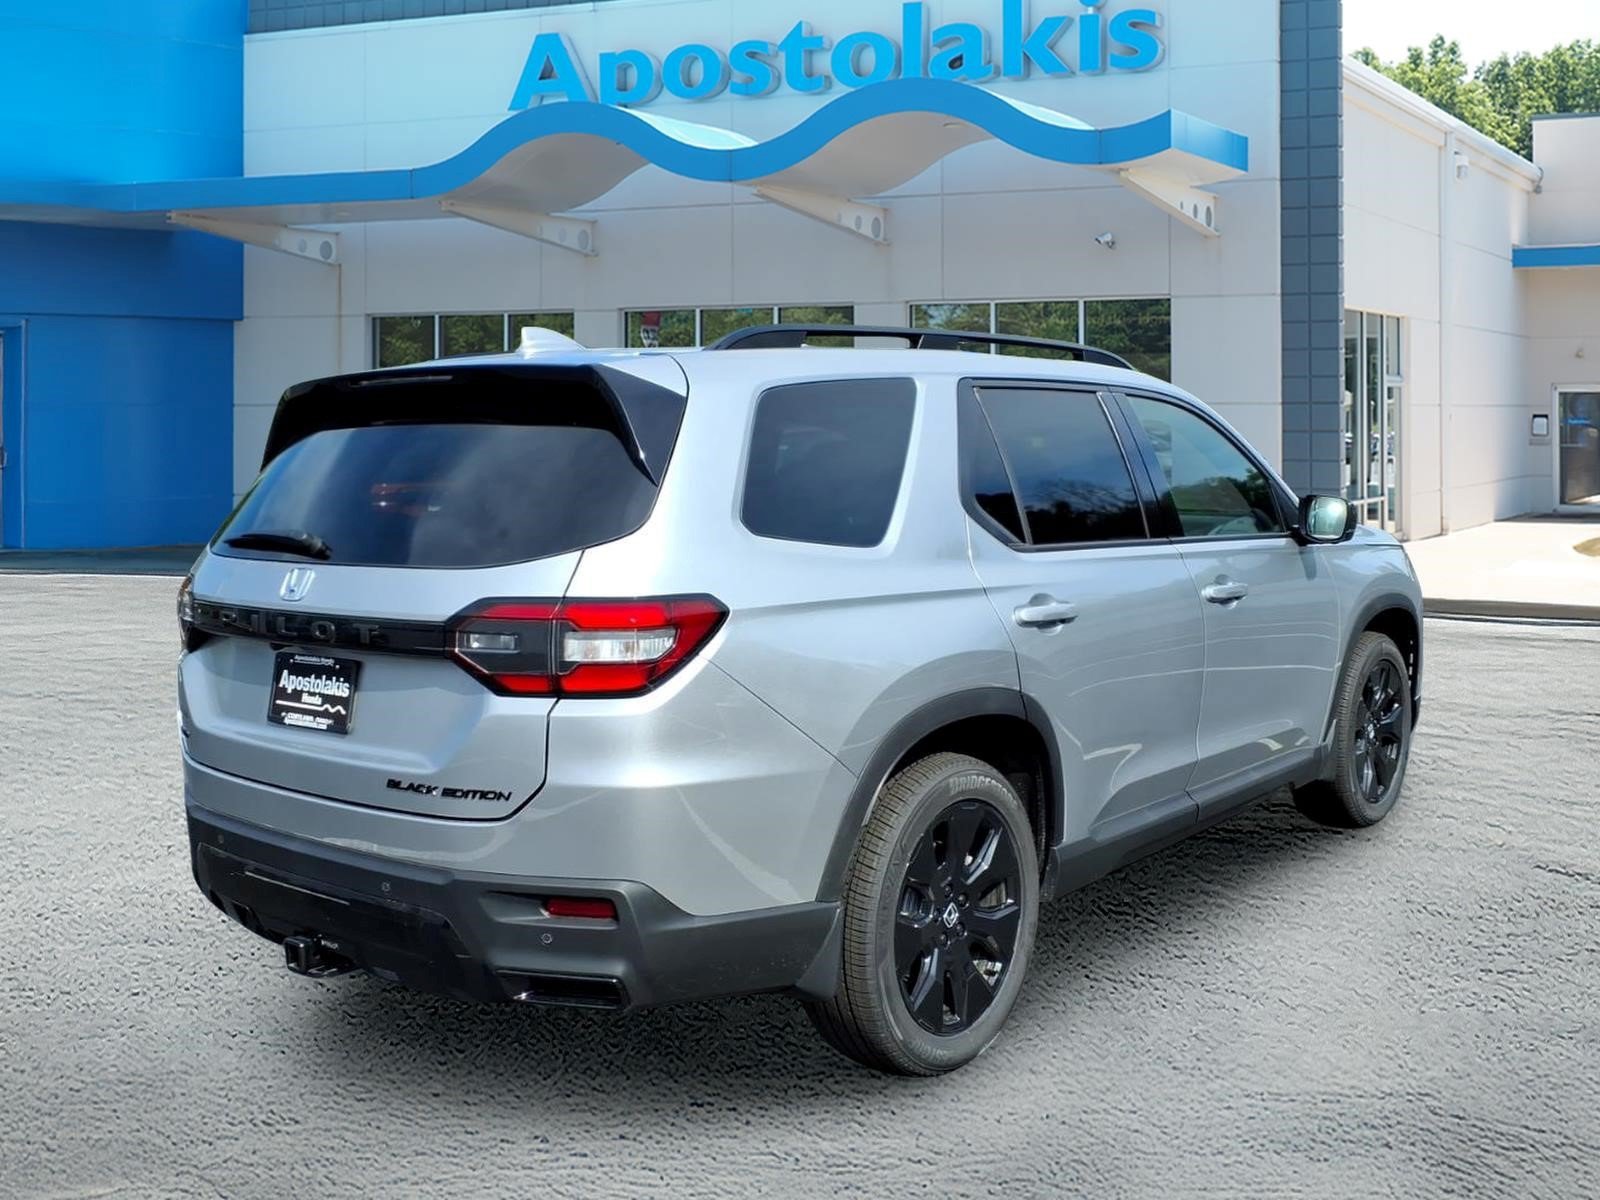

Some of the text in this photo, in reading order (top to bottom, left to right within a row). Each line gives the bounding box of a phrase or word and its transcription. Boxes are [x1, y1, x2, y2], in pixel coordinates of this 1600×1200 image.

[507, 0, 1160, 110] Apostolakis
[278, 669, 350, 698] Apostolakis
[386, 778, 512, 802] BLACK EDITION
